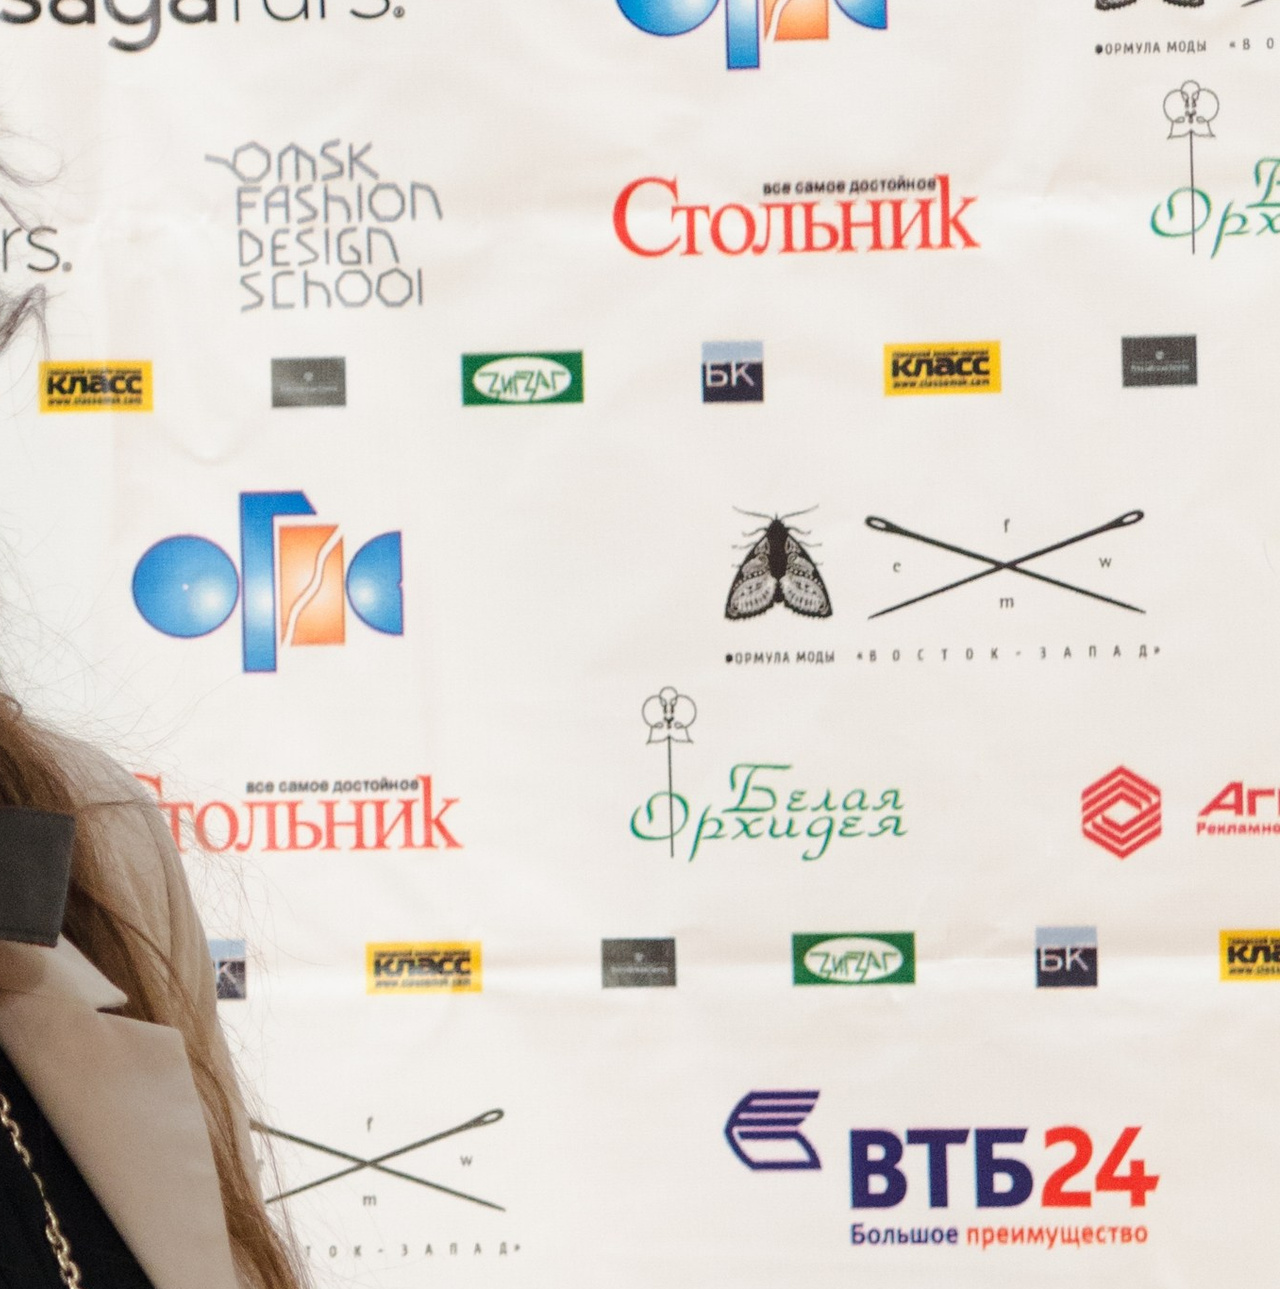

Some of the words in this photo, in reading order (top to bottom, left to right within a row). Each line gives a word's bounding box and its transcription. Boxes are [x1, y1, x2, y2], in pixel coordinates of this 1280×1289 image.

[1167, 40, 1206, 53] МОДЫ
[762, 181, 791, 196] все
[795, 180, 844, 194] самое
[848, 175, 937, 193] достойное
[613, 174, 979, 258] Стольник
[705, 365, 754, 390] БК
[796, 651, 834, 664] МОДЫ
[245, 780, 273, 794] все
[277, 779, 327, 793] самое
[329, 776, 419, 792] достойное
[721, 763, 908, 814] Белая
[629, 791, 909, 863] Орхидея
[1039, 946, 1088, 973] БК
[850, 1126, 1159, 1209] ВТБ24
[851, 1223, 958, 1245] Большое
[967, 1226, 1148, 1250] преимущество
